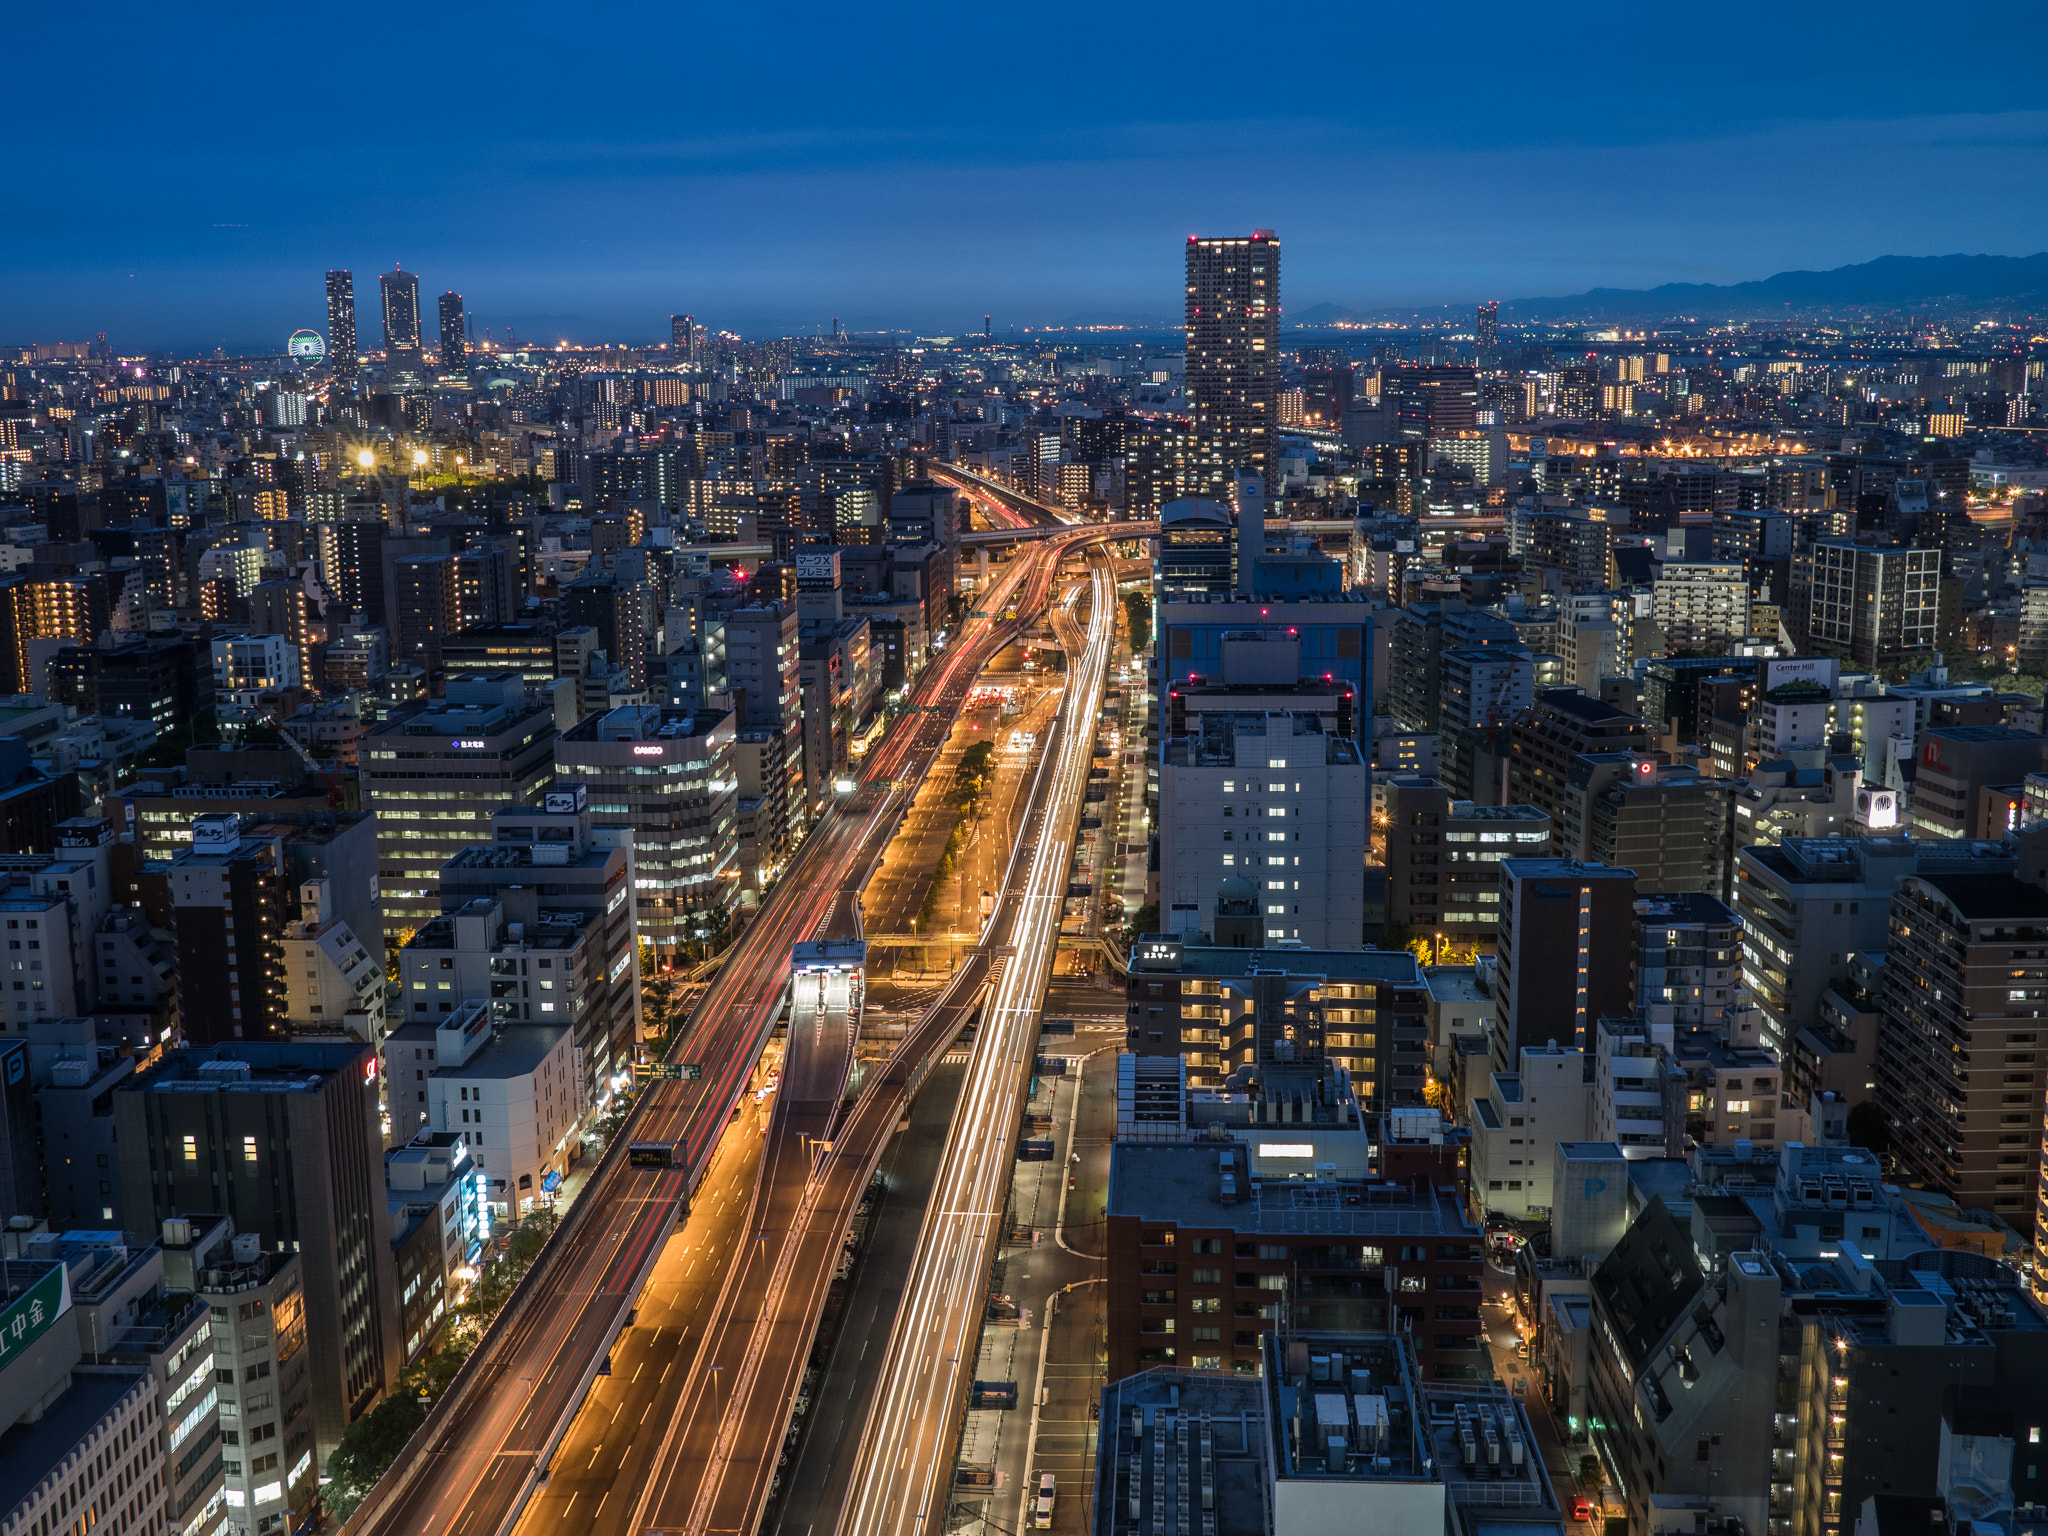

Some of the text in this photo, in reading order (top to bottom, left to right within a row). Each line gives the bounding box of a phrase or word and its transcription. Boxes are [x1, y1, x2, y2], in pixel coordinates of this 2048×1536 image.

[798, 557, 830, 565] マークX
[1802, 663, 1814, 671] Hill
[1152, 945, 1167, 953] 日本
[1143, 952, 1176, 960] エスリード
[10, 1058, 22, 1079] P
[1585, 1179, 1606, 1200] P
[0, 1298, 46, 1357] 工中金
